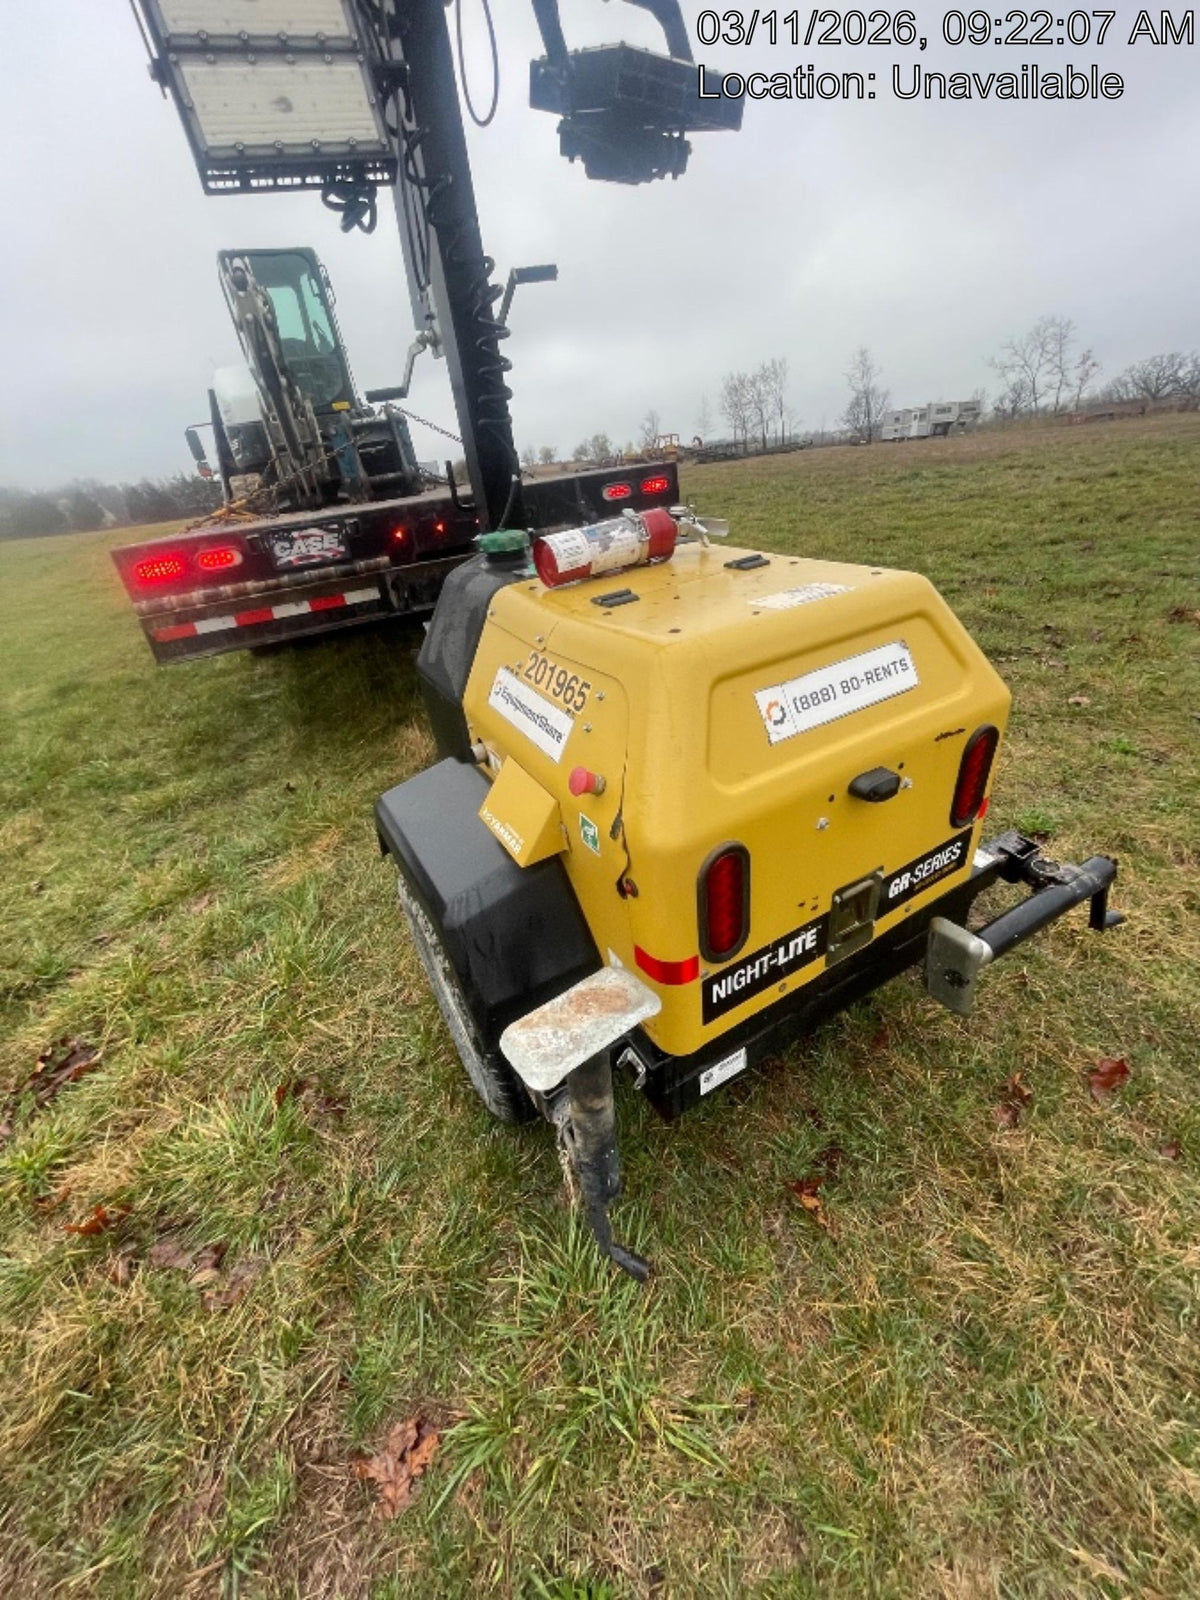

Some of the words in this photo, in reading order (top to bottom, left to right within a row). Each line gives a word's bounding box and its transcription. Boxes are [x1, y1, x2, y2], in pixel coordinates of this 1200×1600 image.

[273, 533, 339, 558] CASE
[524, 653, 591, 711] 201965
[792, 684, 837, 713] (888)
[840, 658, 909, 694] 80-RENTS
[501, 685, 563, 743] EquipmentShare
[712, 927, 817, 1003] NIGHT-LITE
